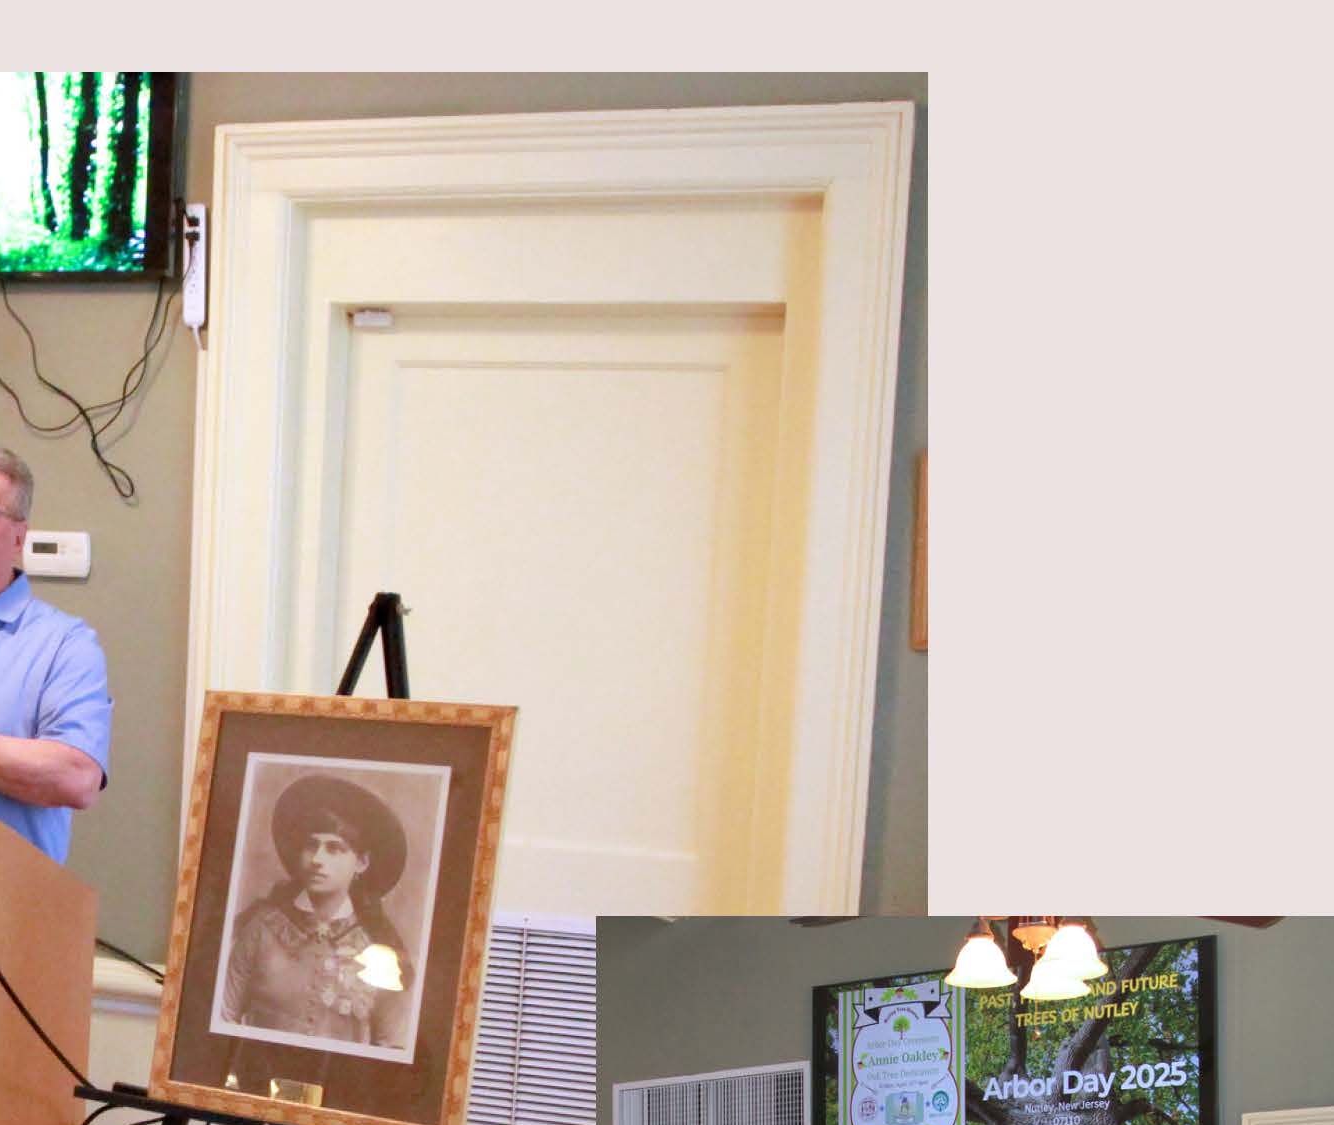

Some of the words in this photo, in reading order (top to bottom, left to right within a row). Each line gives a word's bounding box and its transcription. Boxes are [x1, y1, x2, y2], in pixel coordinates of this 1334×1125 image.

[979, 993, 1016, 1009] PAST,
[1088, 977, 1117, 997] AND
[1121, 973, 1179, 993] FUTURE
[1015, 1010, 1057, 1027] TREES
[1061, 1007, 1082, 1022] OF
[1083, 1001, 1139, 1020] NUTLEY
[868, 1055, 900, 1066] Annie
[902, 1050, 939, 1063] Oakley
[983, 1074, 1058, 1101] Arbor
[1063, 1070, 1116, 1098] Day
[1120, 1060, 1187, 1090] 2025
[1025, 1103, 1057, 1115] Nutley,
[1058, 1101, 1079, 1112] New
[1080, 1099, 1111, 1112] Jersey
